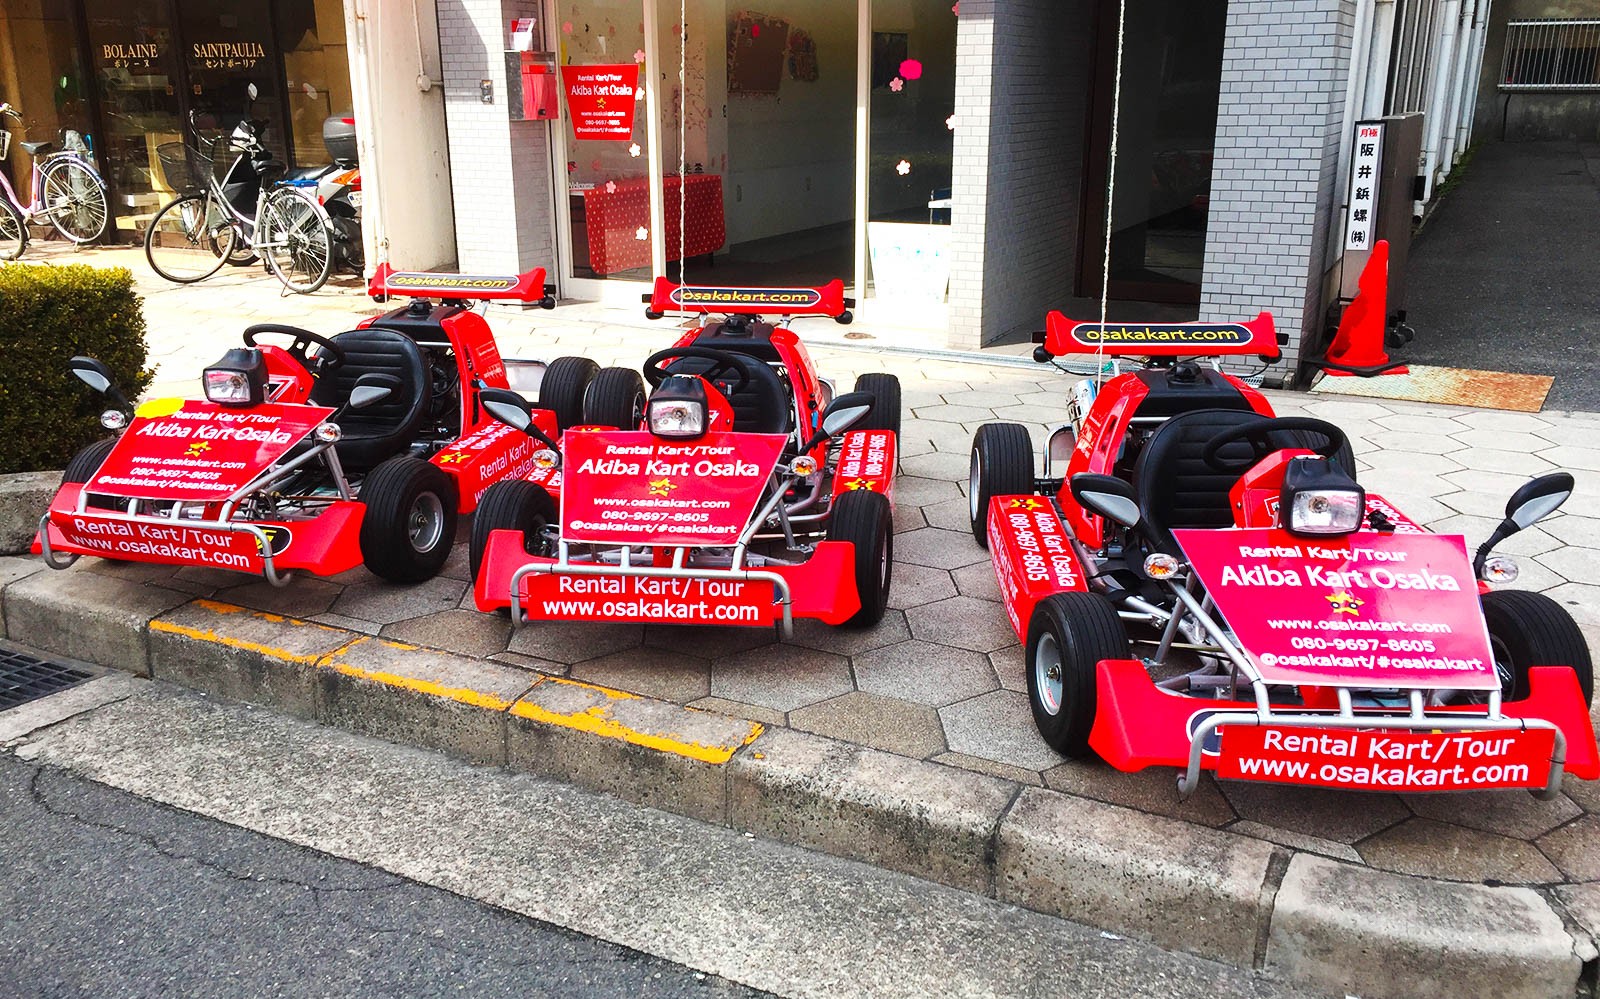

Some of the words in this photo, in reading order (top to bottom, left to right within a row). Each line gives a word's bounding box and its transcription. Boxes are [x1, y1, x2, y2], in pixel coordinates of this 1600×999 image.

[103, 44, 158, 59] BOLAINE
[193, 43, 265, 58] SAINTPAULIA
[571, 84, 592, 95] Akiba
[594, 84, 609, 95] Kart
[609, 84, 632, 95] Osaka
[395, 276, 508, 288] osakakart.com
[682, 290, 809, 302] osakakart.com
[1086, 327, 1239, 341] osakakart.com
[170, 410, 214, 423] Rental
[215, 412, 282, 425] Kart/Tour
[136, 422, 195, 438] Akiba
[196, 425, 236, 441] Kart
[238, 428, 292, 445] Osaka
[606, 445, 658, 456] Rental
[660, 444, 735, 456] Kart/Tour
[131, 455, 247, 470] www.osakakart.com
[479, 451, 508, 481] Rental
[577, 459, 640, 476] Akiba
[645, 459, 692, 476] Kart
[694, 459, 760, 477] Osaka
[129, 467, 222, 481] 080-9697-8605
[98, 475, 237, 493] @osakakart/#osakakart
[593, 497, 730, 509] www.osakakart.com
[601, 511, 709, 522] 080-9697-8605
[1033, 511, 1056, 533] Akiba
[74, 518, 135, 537] Rental
[140, 521, 232, 548] Kart/Tour
[569, 520, 737, 535] @osakakart/#osakakart
[70, 534, 250, 568] www.osakakart.com
[1009, 513, 1050, 581] 080-9697-8605
[1042, 535, 1067, 554] Kart
[1239, 545, 1302, 559] Rental
[1308, 546, 1408, 563] Kart/Tour
[1051, 555, 1078, 587] Osaka
[1221, 565, 1301, 587] Akiba
[1309, 566, 1368, 589] Kart
[1370, 568, 1460, 592] Osaka
[559, 575, 627, 594] Rental
[634, 575, 745, 598] Kart/Tour
[543, 598, 759, 621] www.osakakart.com
[1268, 617, 1451, 633] www.osakakart.com
[1291, 636, 1436, 653] 080-9697-8605
[1260, 653, 1485, 672] @osakakart/#osakakart
[1264, 729, 1356, 758] Rental
[1368, 736, 1515, 763] Kart/Tour
[1239, 756, 1528, 786] www.osakakart.com
